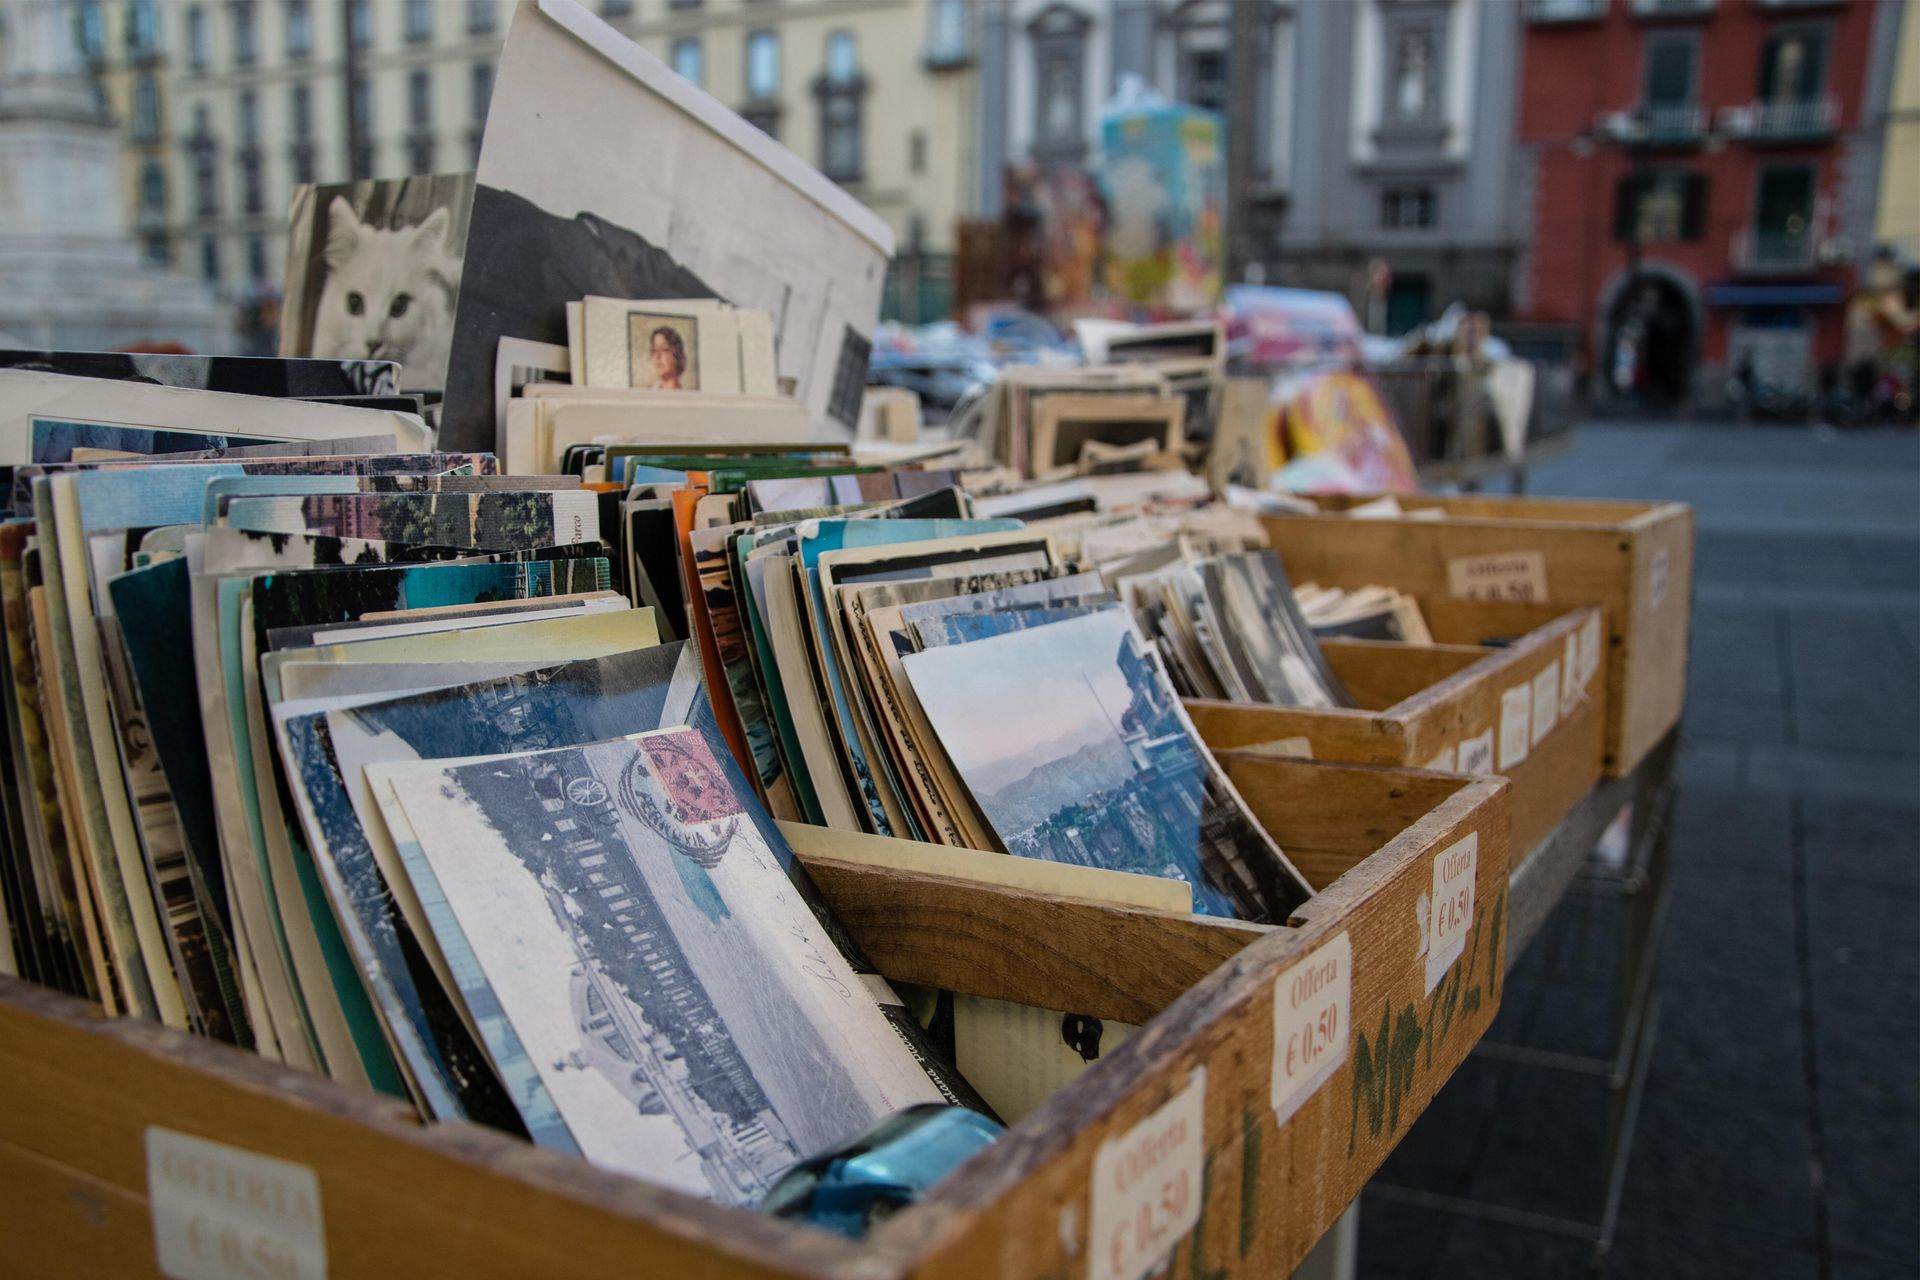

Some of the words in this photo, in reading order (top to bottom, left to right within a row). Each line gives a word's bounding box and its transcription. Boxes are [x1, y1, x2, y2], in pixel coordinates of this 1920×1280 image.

[1443, 850, 1471, 885] Offerta
[1448, 886, 1470, 931] 0,50
[1291, 959, 1338, 1009] Offerta
[1286, 1033, 1298, 1077] €
[1302, 1003, 1337, 1064] 0,50
